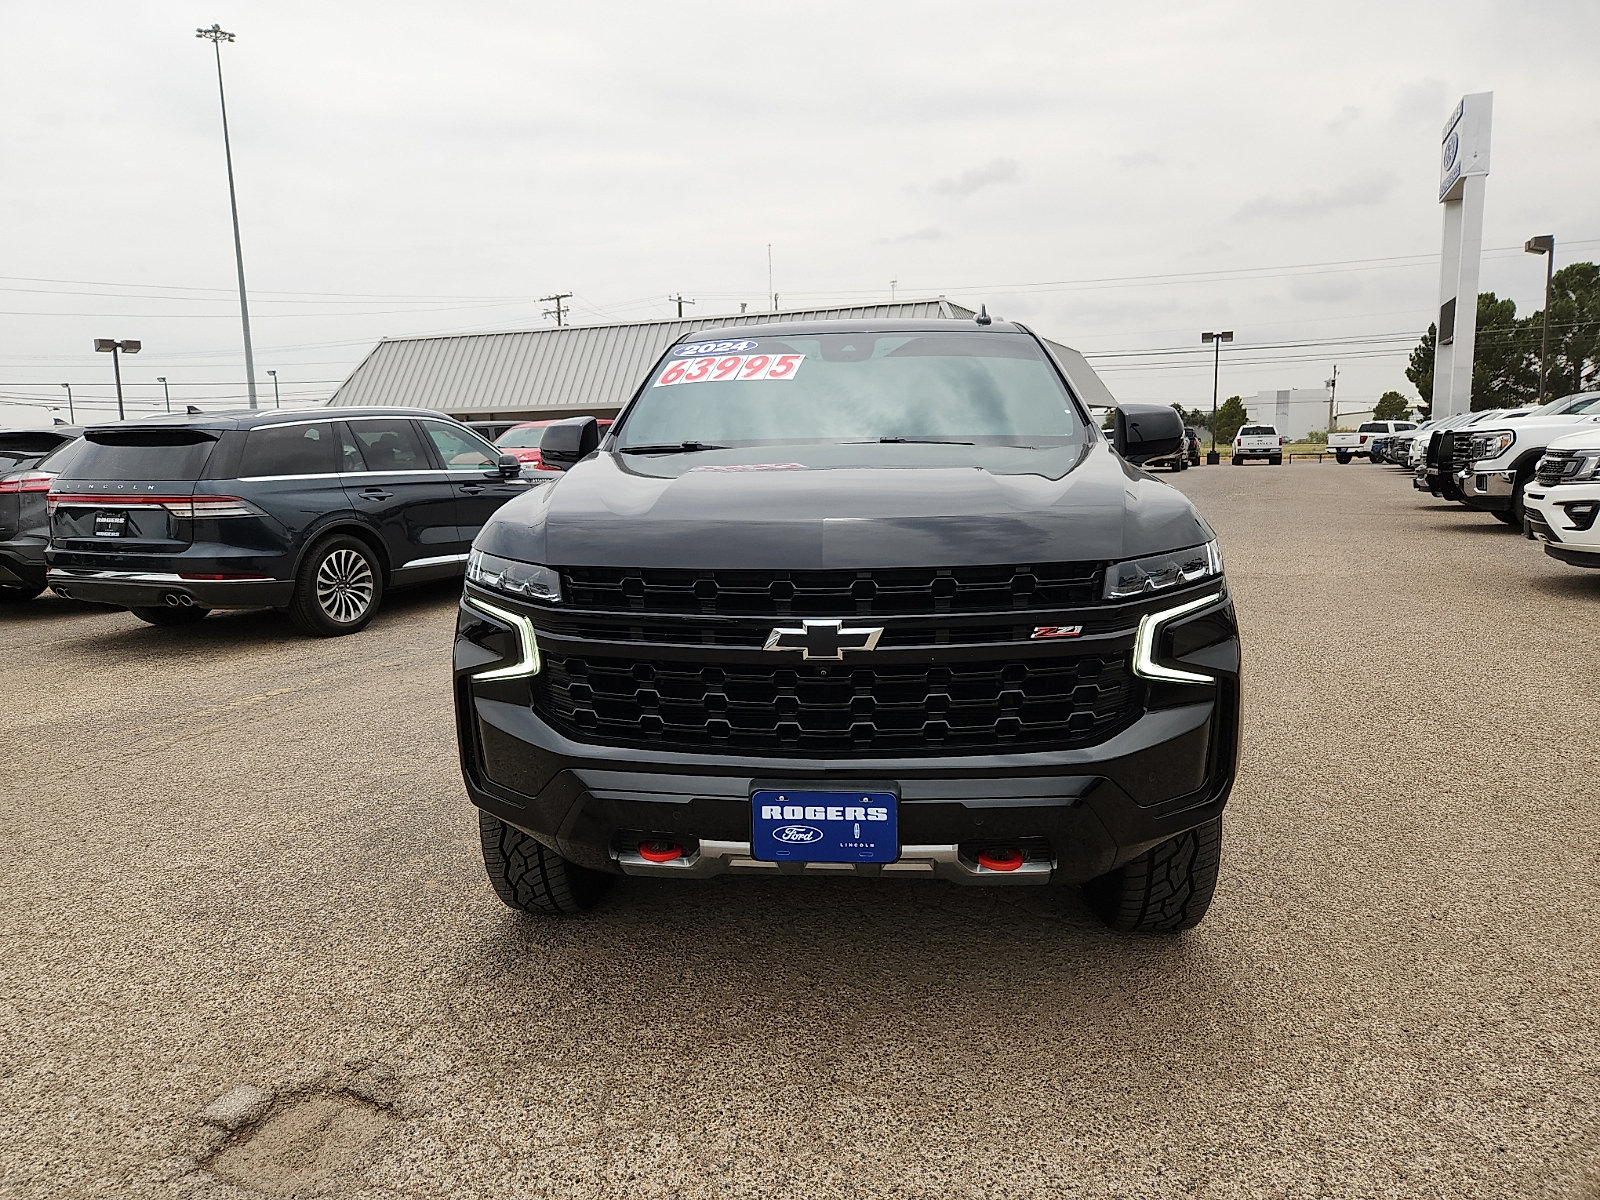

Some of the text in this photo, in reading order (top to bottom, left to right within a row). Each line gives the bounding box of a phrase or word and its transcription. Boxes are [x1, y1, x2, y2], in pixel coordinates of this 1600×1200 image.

[683, 341, 749, 356] 2024
[658, 354, 805, 385] 63995
[1031, 626, 1083, 638] Z71
[761, 805, 888, 821] ROGERS
[782, 827, 813, 841] Ford
